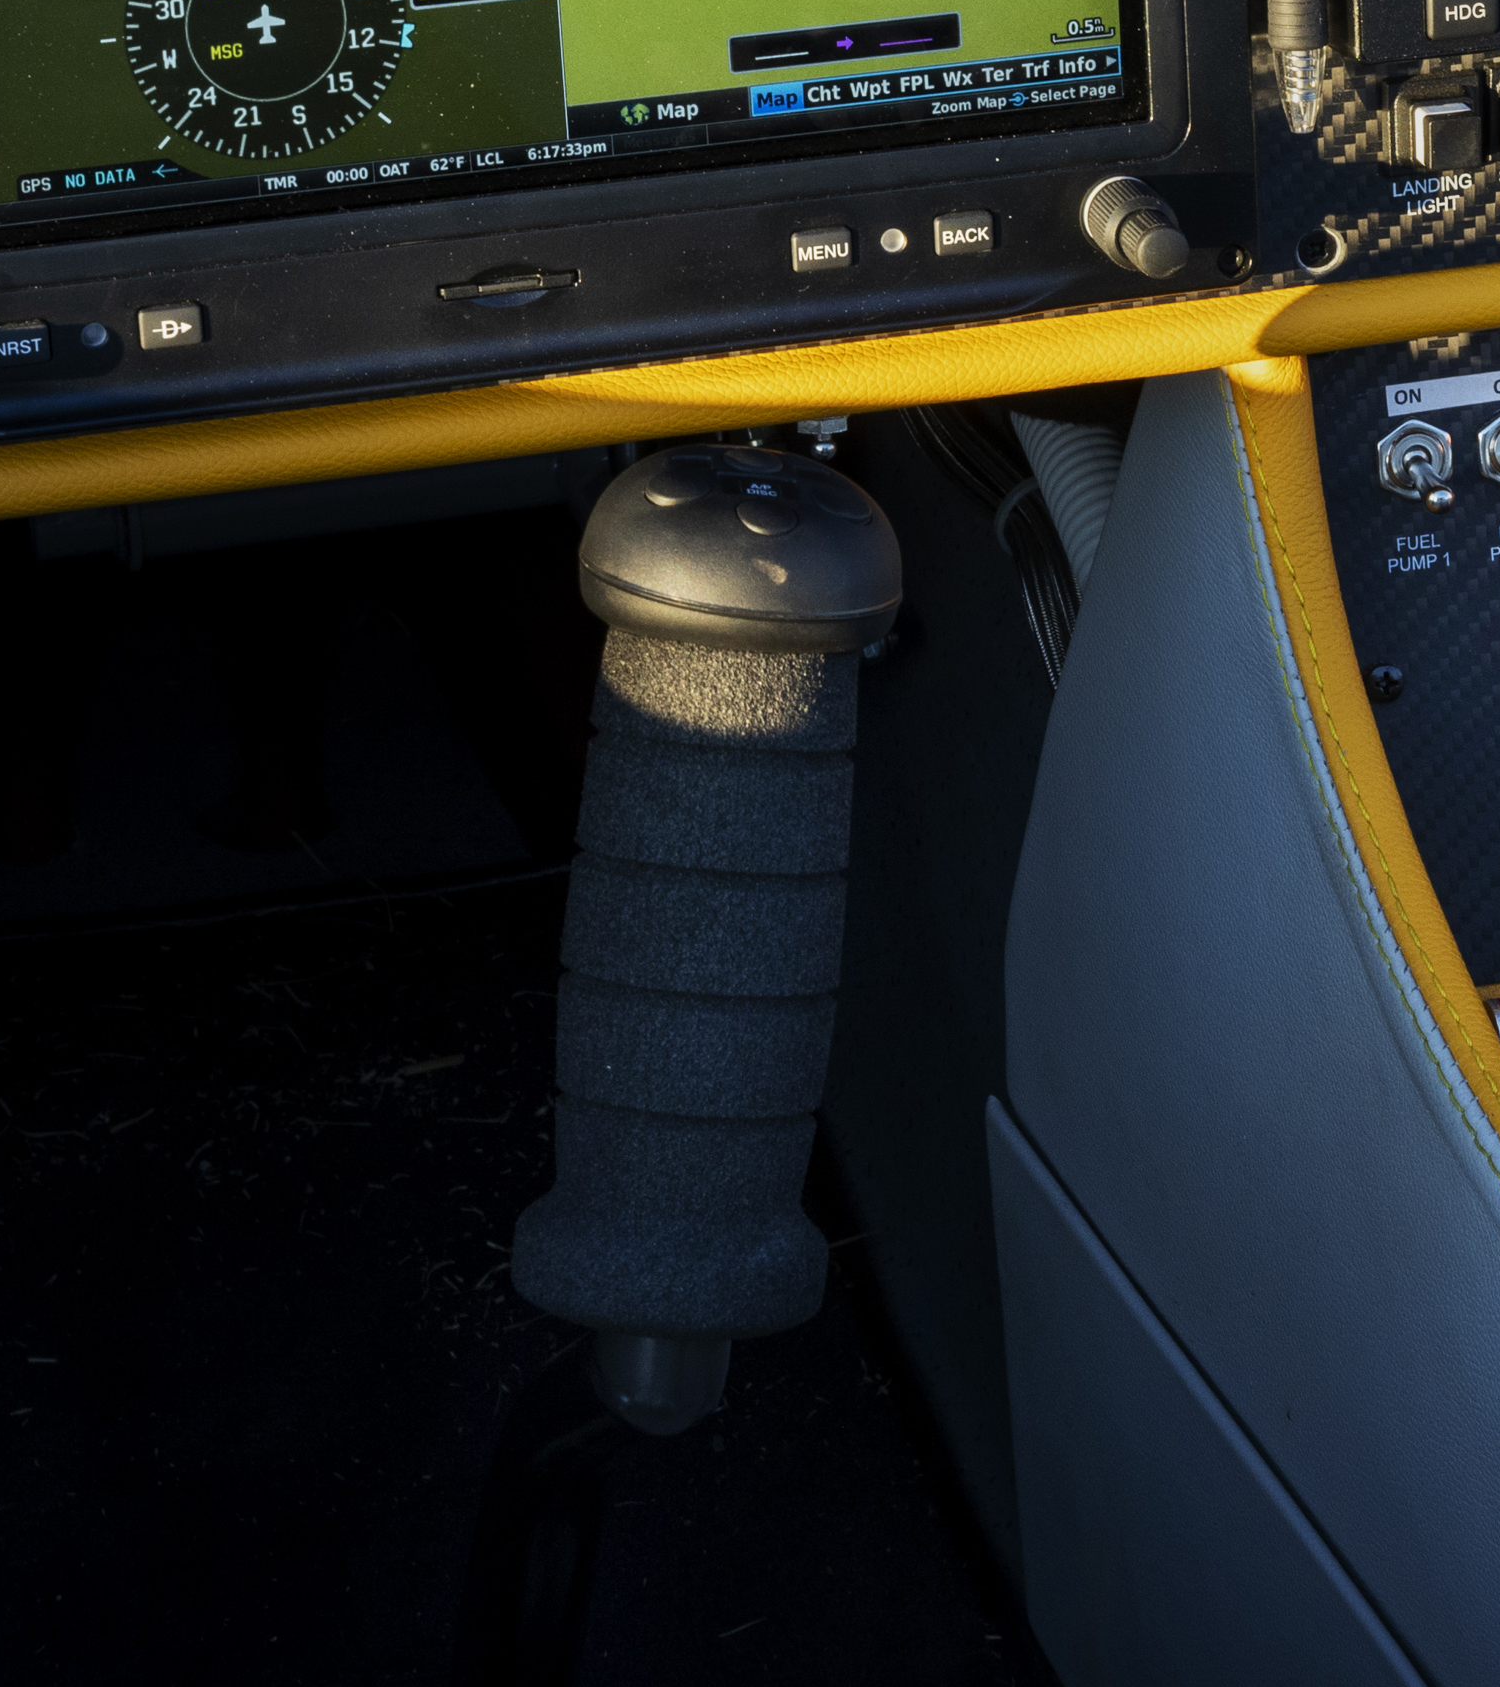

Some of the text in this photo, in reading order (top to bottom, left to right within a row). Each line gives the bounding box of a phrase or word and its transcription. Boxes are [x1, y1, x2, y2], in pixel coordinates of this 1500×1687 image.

[849, 53, 1097, 101] Wpt FPL Info
[931, 81, 1117, 114] Zoom Map Select Page
[527, 141, 607, 161] 6:17:33pm
[1391, 172, 1473, 199] LANDING
[1406, 192, 1461, 216] LIGHT
[941, 225, 990, 245] BACK
[797, 242, 849, 262] MENU
[1393, 386, 1423, 406] ON
